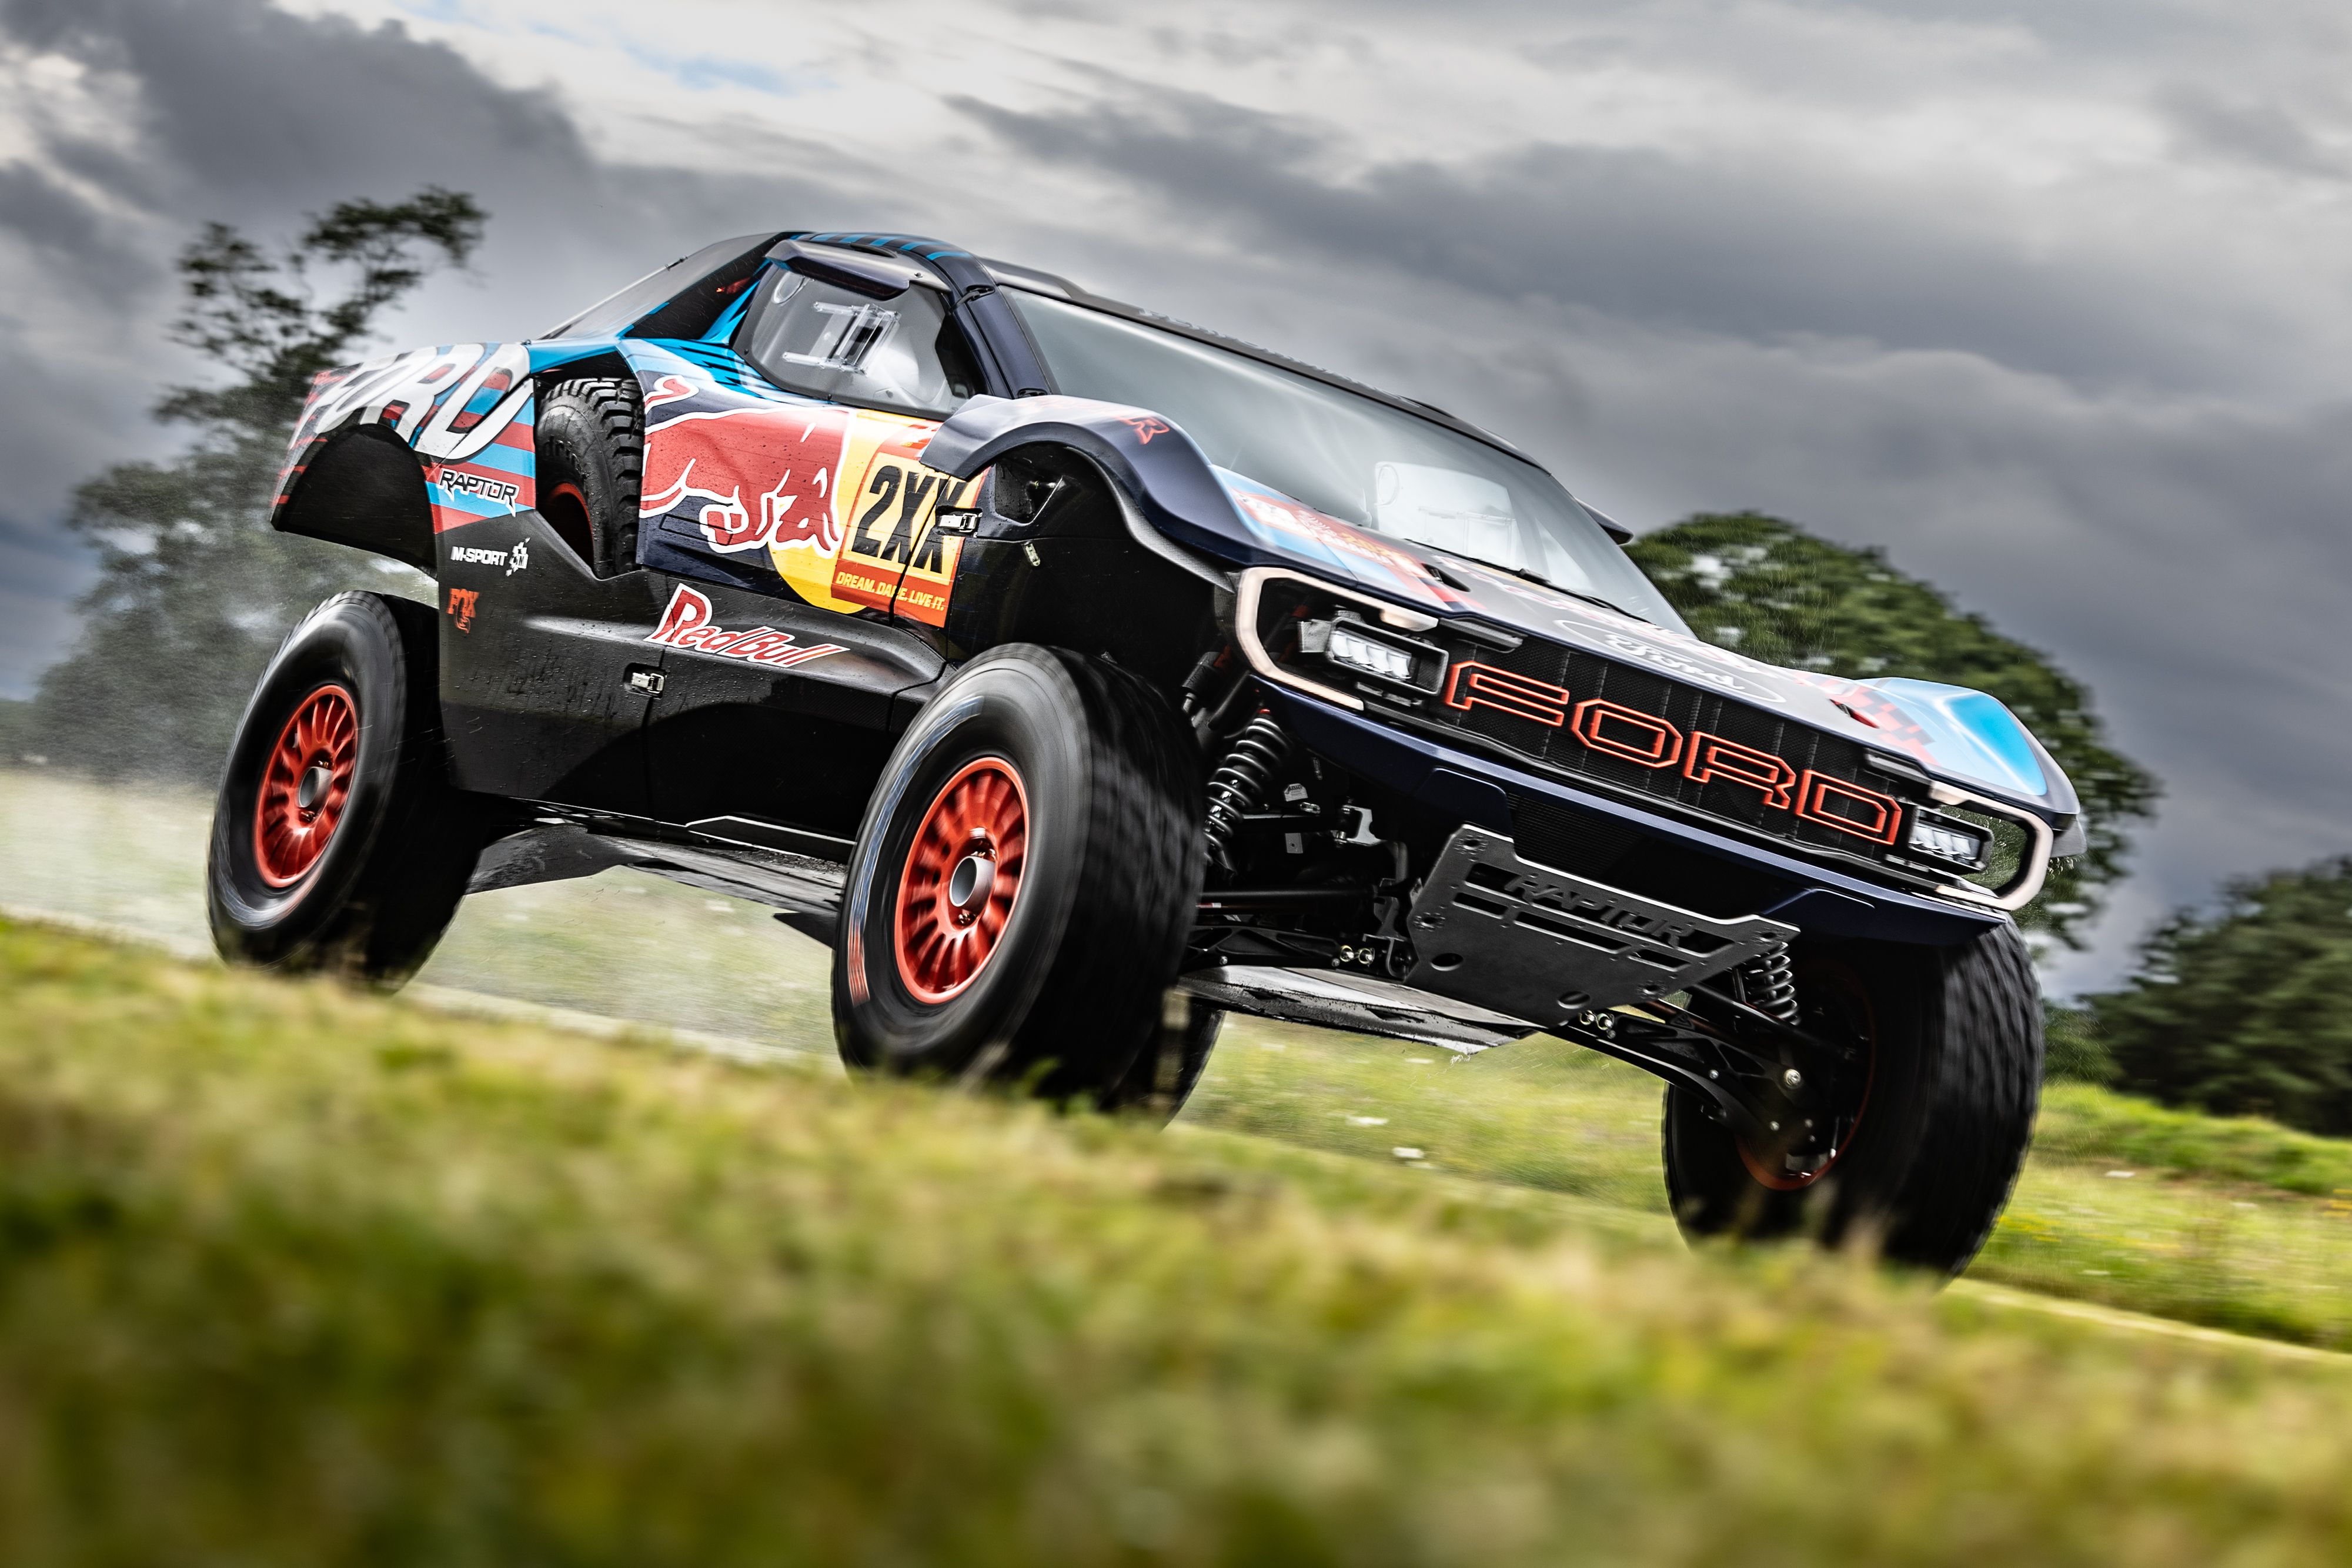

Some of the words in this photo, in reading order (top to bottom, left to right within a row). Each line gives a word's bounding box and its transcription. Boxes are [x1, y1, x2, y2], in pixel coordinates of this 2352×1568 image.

[439, 468, 519, 516] RAPTOR
[850, 465, 969, 574] 2XX
[450, 546, 507, 566] M-SPORT
[446, 589, 479, 634] FOX
[836, 571, 875, 593] DREAM.
[908, 590, 934, 606] LIVE
[931, 597, 946, 611] IT.
[646, 584, 773, 651] Red
[719, 632, 848, 666] Bull
[1606, 633, 1745, 691] Ford
[1445, 660, 1902, 845] FORD
[1504, 875, 1696, 949] RAPTOR
